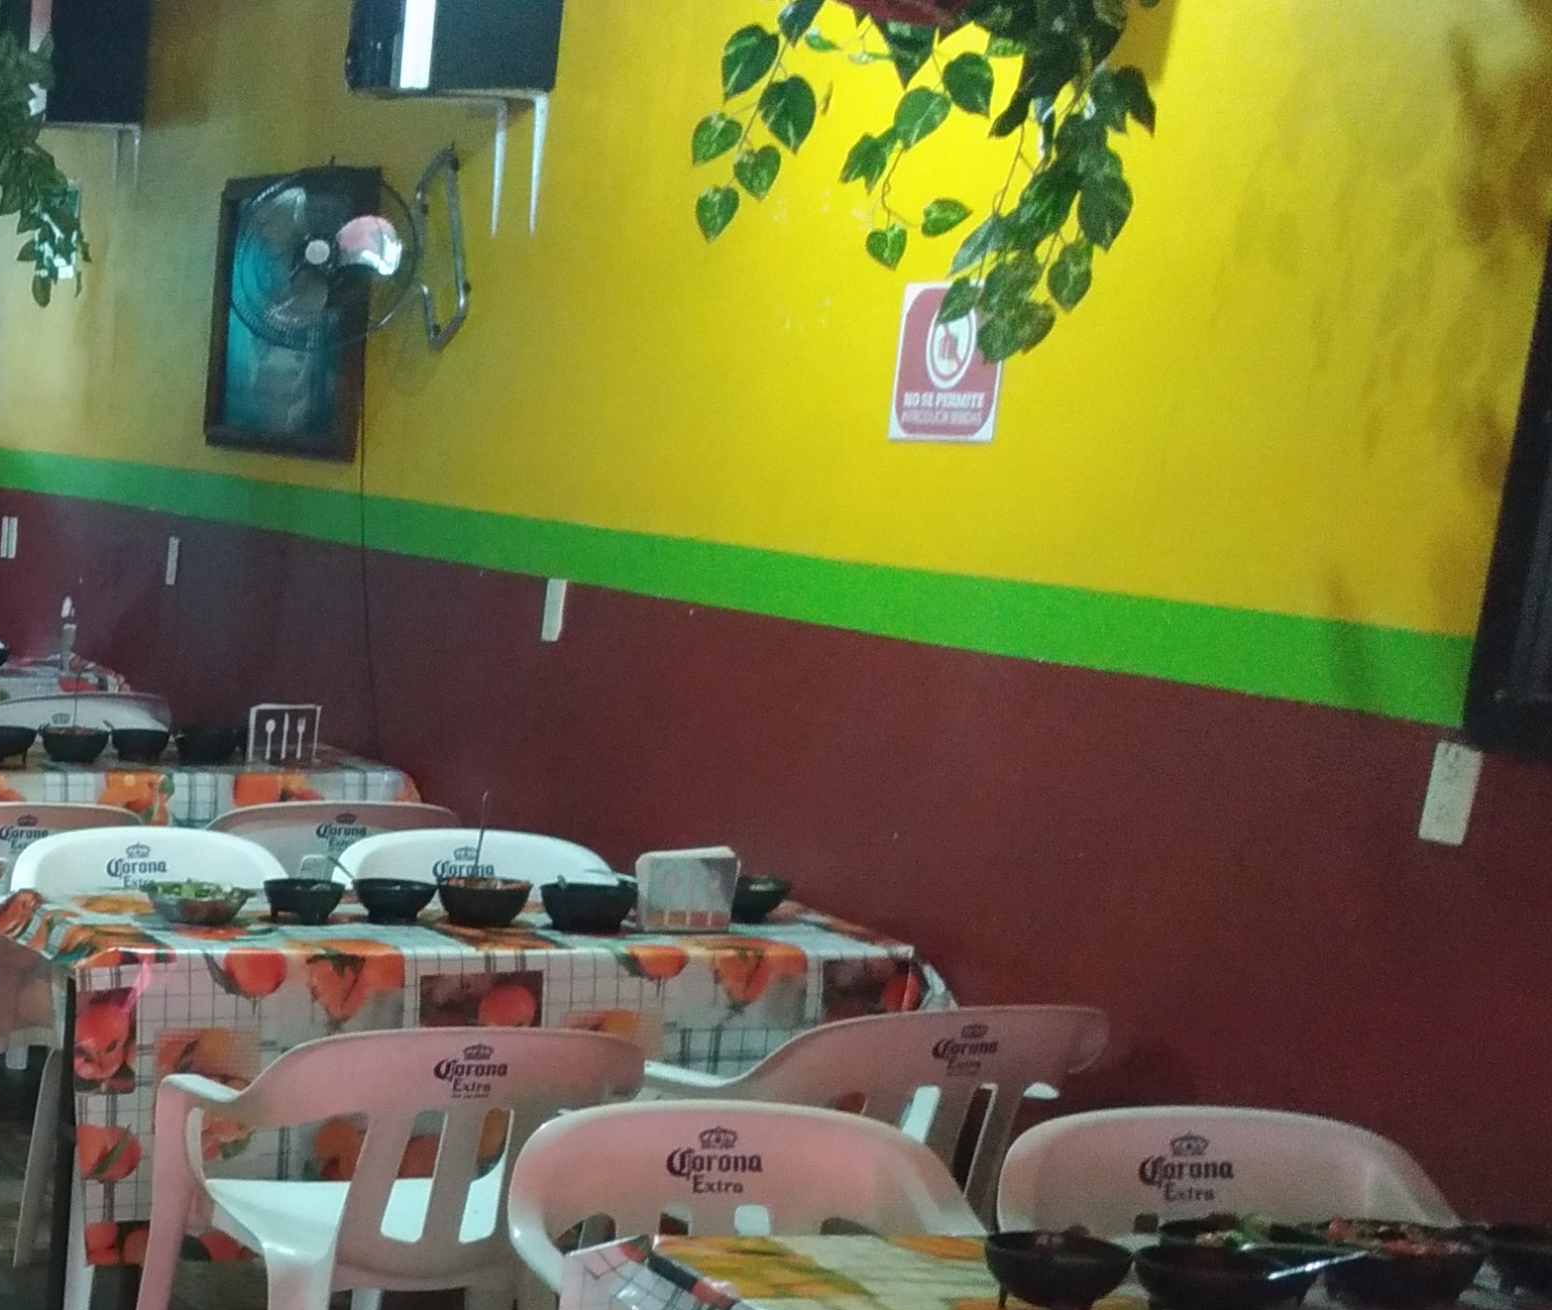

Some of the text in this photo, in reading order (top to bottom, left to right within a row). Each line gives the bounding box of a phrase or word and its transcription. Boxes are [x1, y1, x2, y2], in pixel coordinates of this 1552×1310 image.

[315, 823, 367, 839] Corona
[106, 858, 168, 879] Corona
[932, 1038, 999, 1060] Corona
[434, 1058, 508, 1082] Corona
[452, 1078, 491, 1093] Extra
[665, 1146, 763, 1181] Corona
[1139, 1155, 1234, 1188] Corona
[693, 1174, 744, 1194] Extra
[1165, 1182, 1215, 1202] Extra
